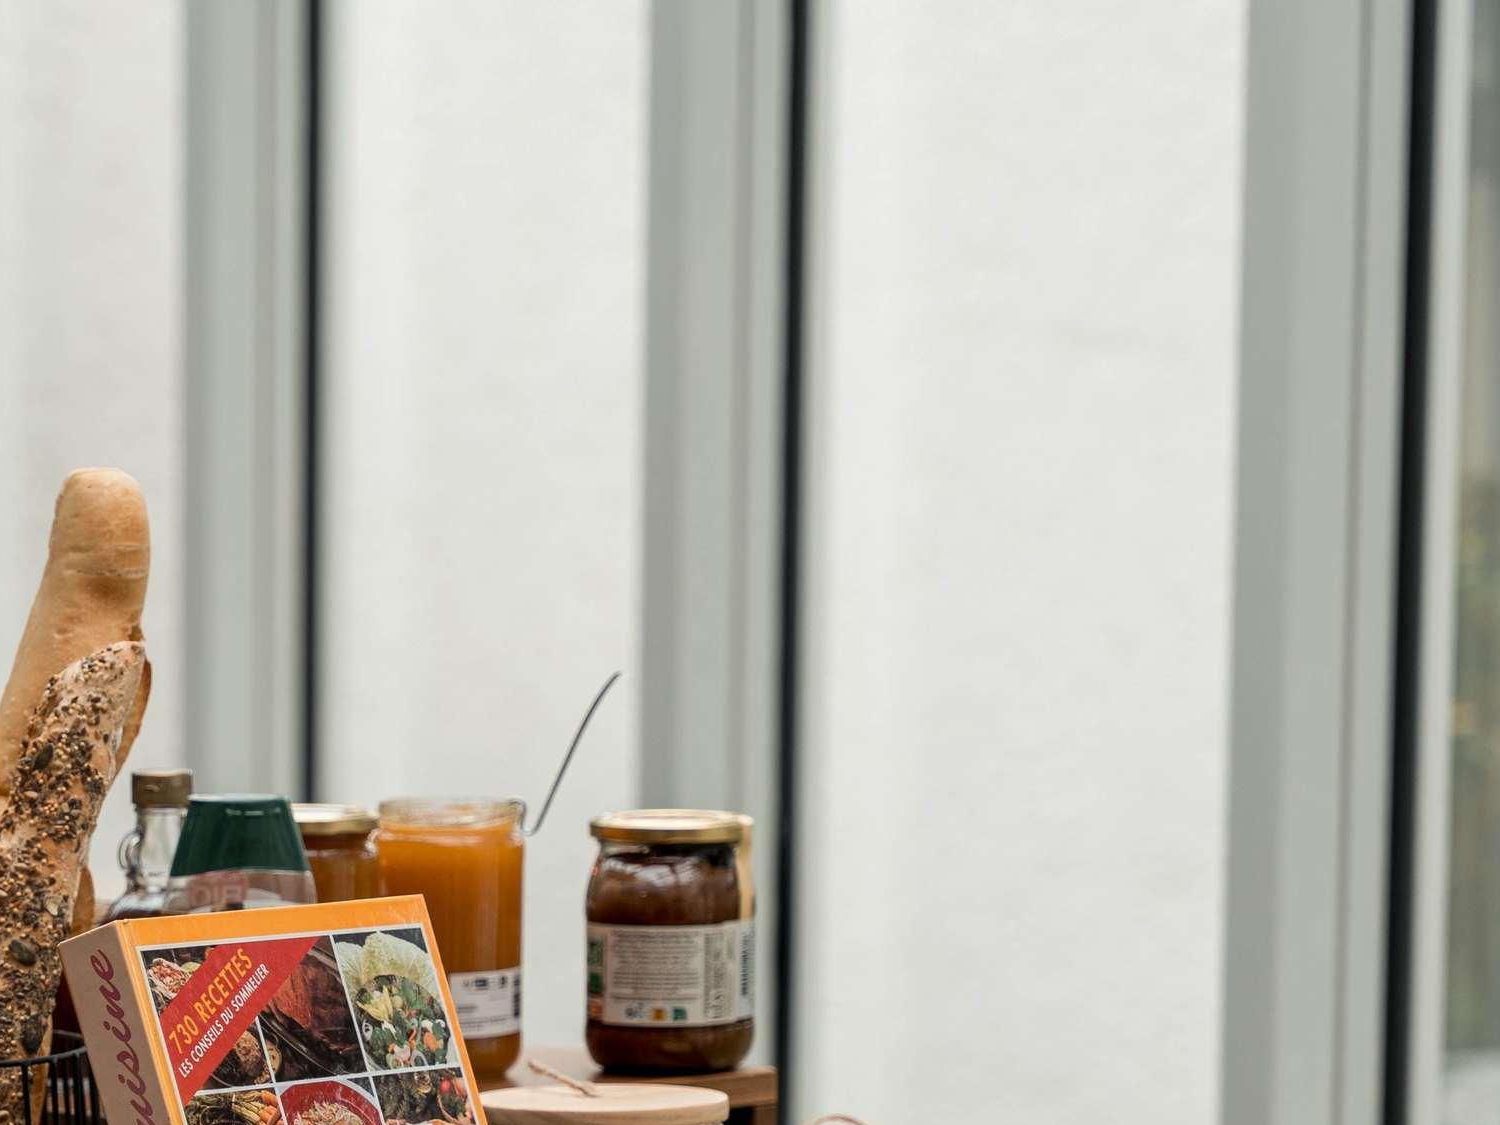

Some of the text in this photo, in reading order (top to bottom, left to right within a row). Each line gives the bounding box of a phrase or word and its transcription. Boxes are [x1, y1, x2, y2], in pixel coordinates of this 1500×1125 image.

[168, 947, 253, 1055] 730 RECETTES
[177, 963, 270, 1078] LES CONSEILS DU SOMMELIER
